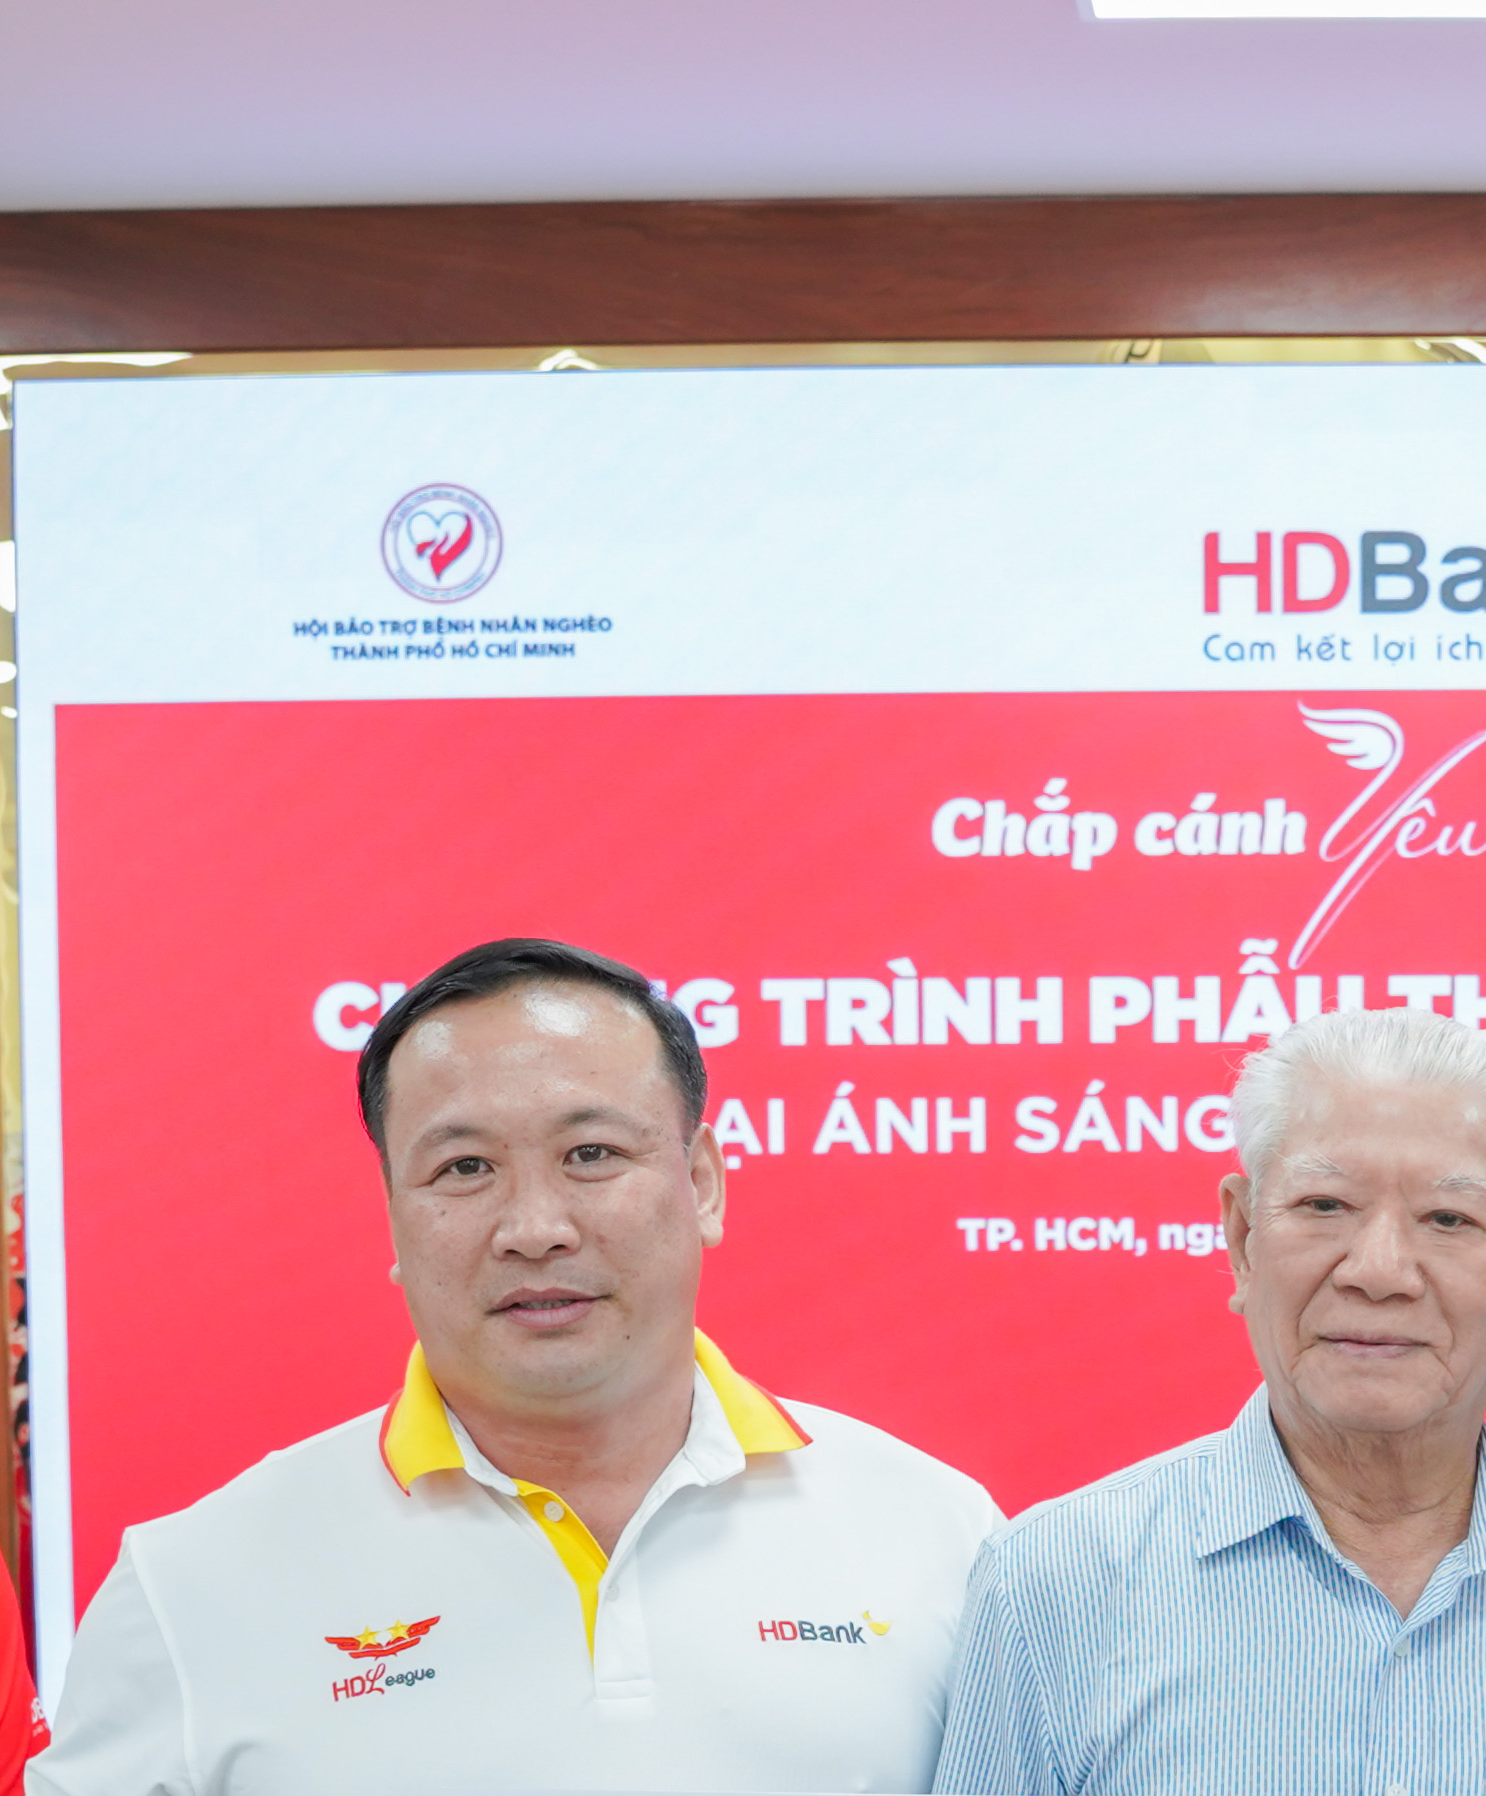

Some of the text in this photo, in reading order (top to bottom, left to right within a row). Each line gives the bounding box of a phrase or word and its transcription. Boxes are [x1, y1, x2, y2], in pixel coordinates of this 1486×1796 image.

[293, 618, 328, 639] HỘI
[334, 616, 374, 636] BẢO
[423, 615, 475, 637] BỆNH
[480, 615, 537, 634] NHÂN
[543, 614, 613, 634] NGHÈO
[331, 641, 399, 661] THÀNH
[405, 637, 445, 660] PHỐ
[485, 639, 516, 659] CHÍ
[523, 642, 576, 658] MINH
[1203, 633, 1276, 661] Cam
[1296, 632, 1352, 661] kết
[1374, 635, 1416, 666] lợi
[931, 776, 1118, 871] Chắp
[1133, 791, 1307, 857] cánh
[761, 956, 1063, 1045] TRÌNH
[1088, 937, 1365, 1045] PHẪU
[713, 1096, 786, 1170] ẠI
[814, 1080, 987, 1155] ÁNH
[1014, 1078, 1238, 1154] SÁNG
[956, 1217, 1024, 1252] TP.
[1033, 1216, 1148, 1257] HCM,
[758, 1619, 868, 1645] HDBank
